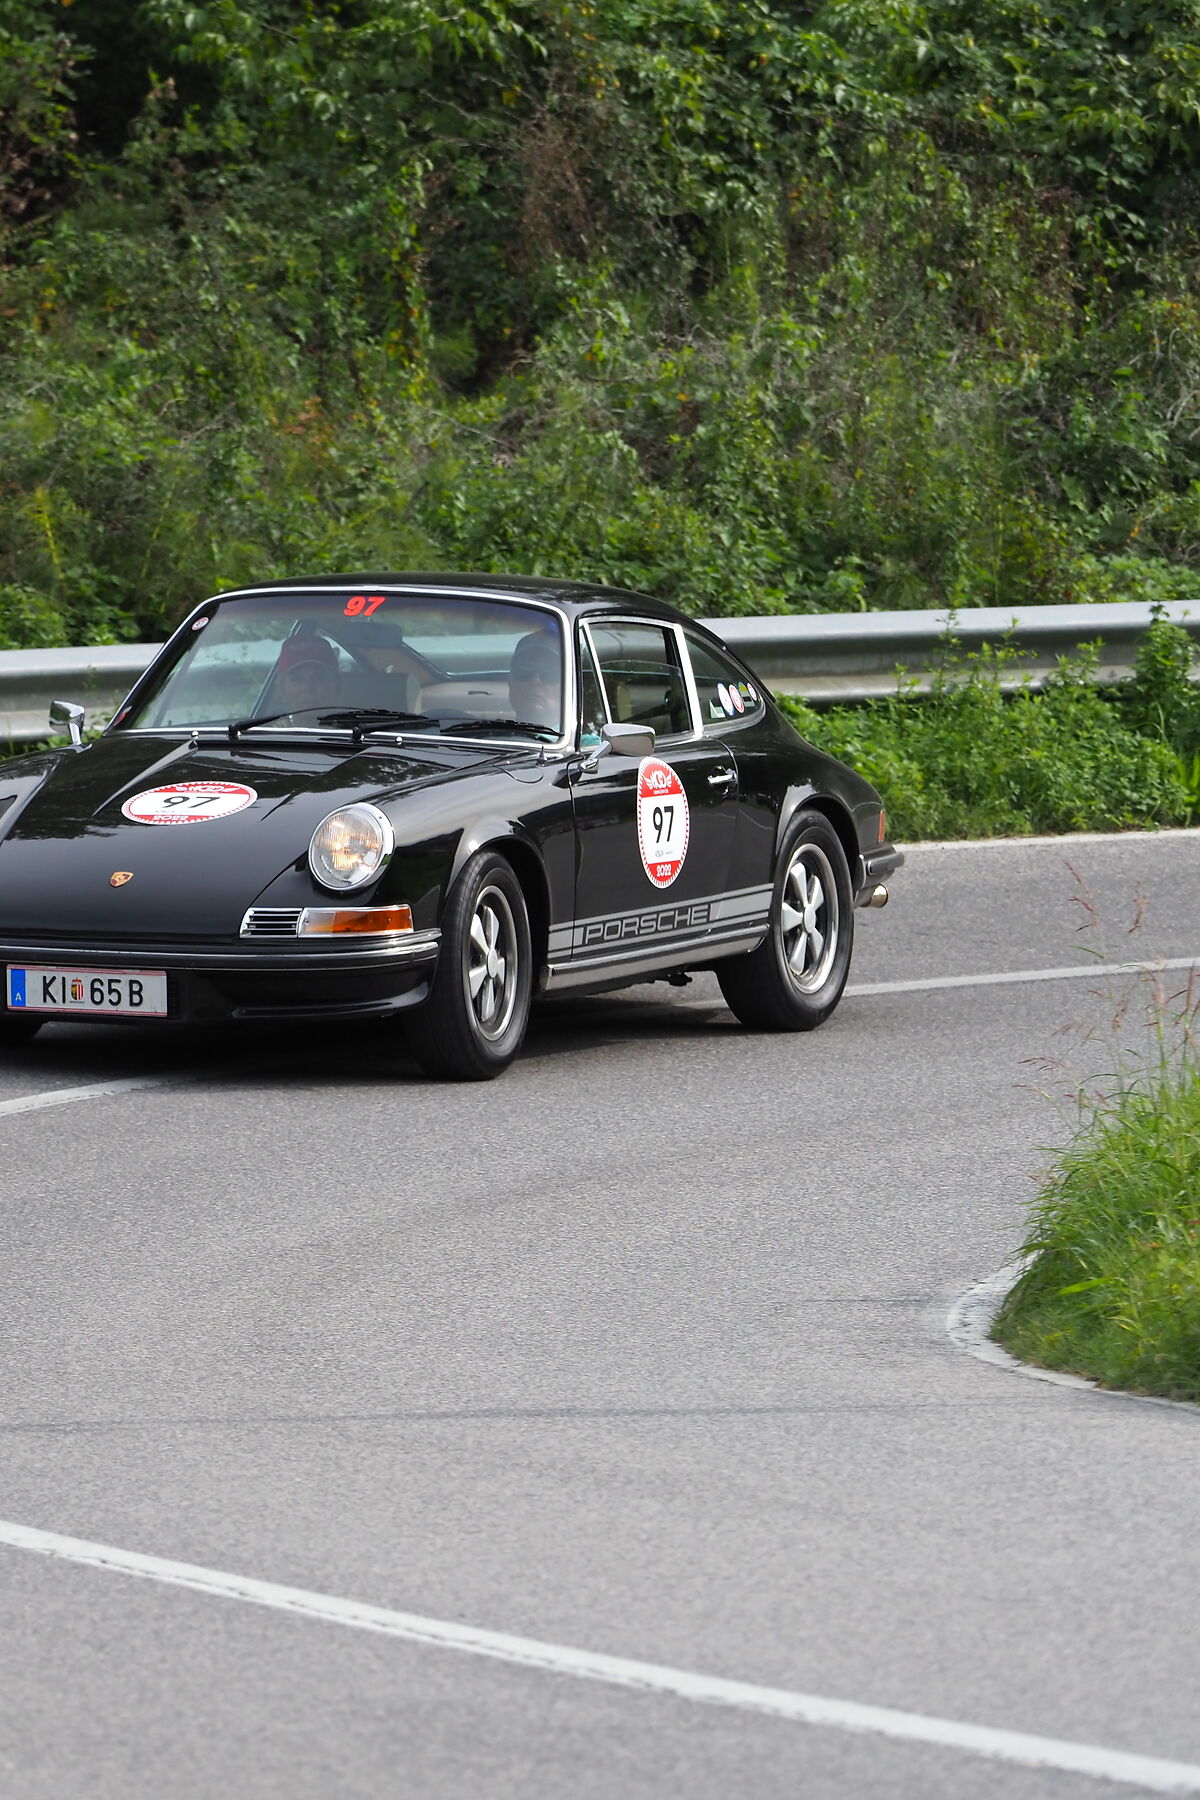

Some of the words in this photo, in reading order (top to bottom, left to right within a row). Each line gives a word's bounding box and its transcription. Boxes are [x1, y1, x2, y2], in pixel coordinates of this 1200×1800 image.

[344, 596, 385, 616] 97
[162, 796, 220, 808] 97
[653, 806, 673, 843] 97
[656, 864, 672, 877] 2022
[585, 904, 708, 944] PORSCHE
[15, 993, 22, 1001] A
[42, 976, 66, 1004] KI
